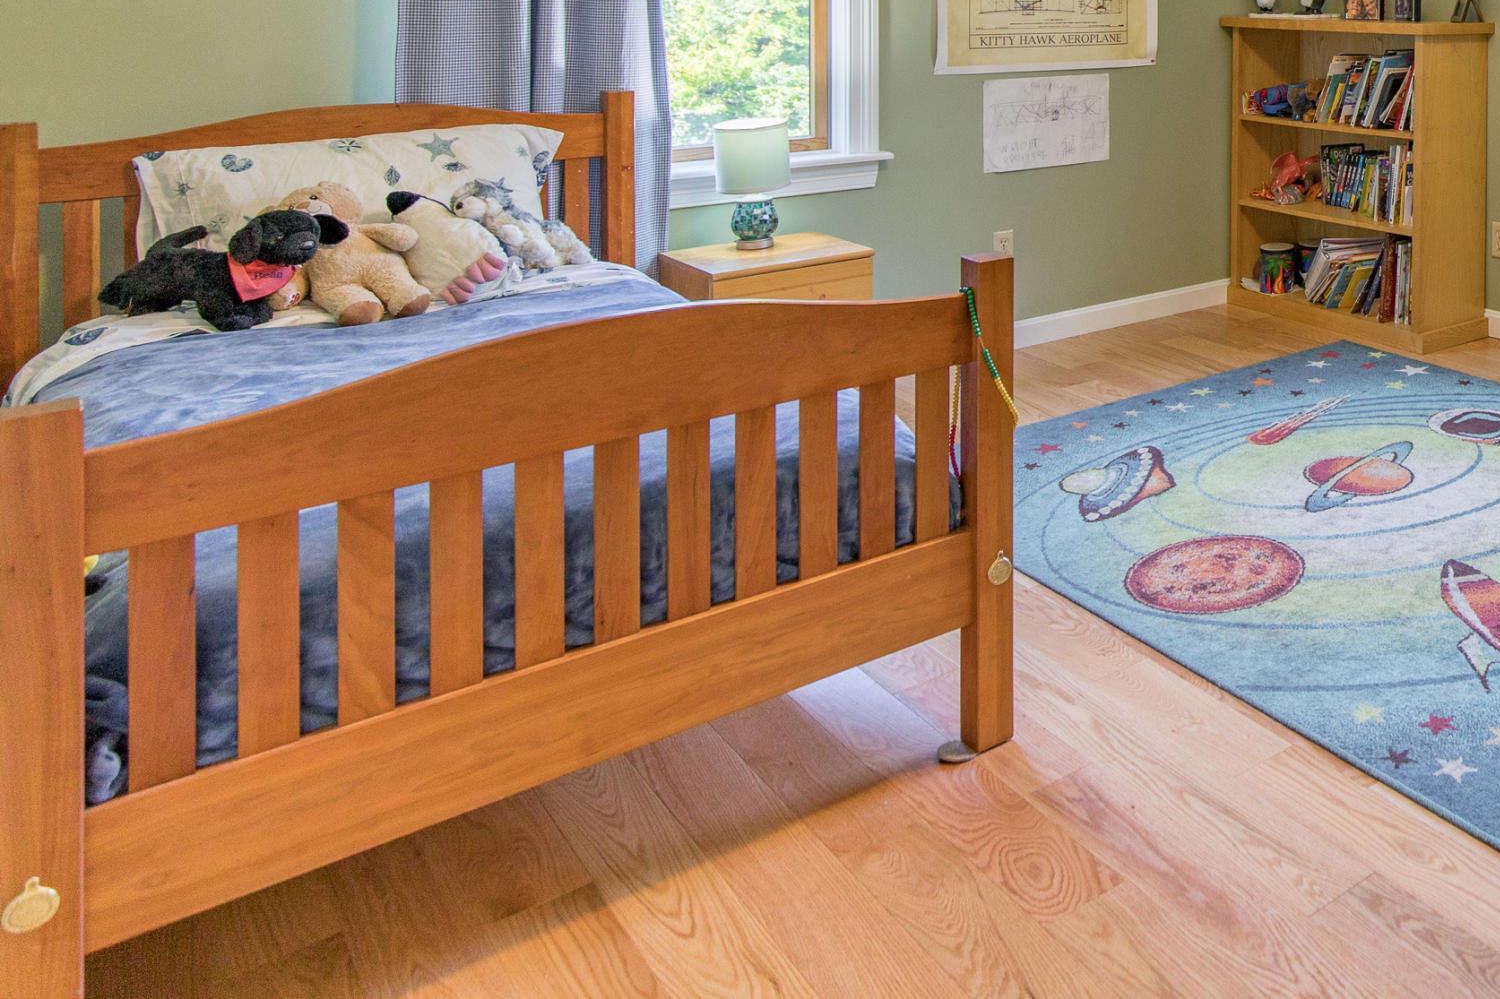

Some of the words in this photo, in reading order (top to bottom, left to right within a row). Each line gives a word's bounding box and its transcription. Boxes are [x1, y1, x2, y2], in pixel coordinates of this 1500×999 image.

[979, 36, 1018, 47] KITTY
[1020, 34, 1056, 46] HAWK
[1059, 33, 1122, 45] AEROPLANE
